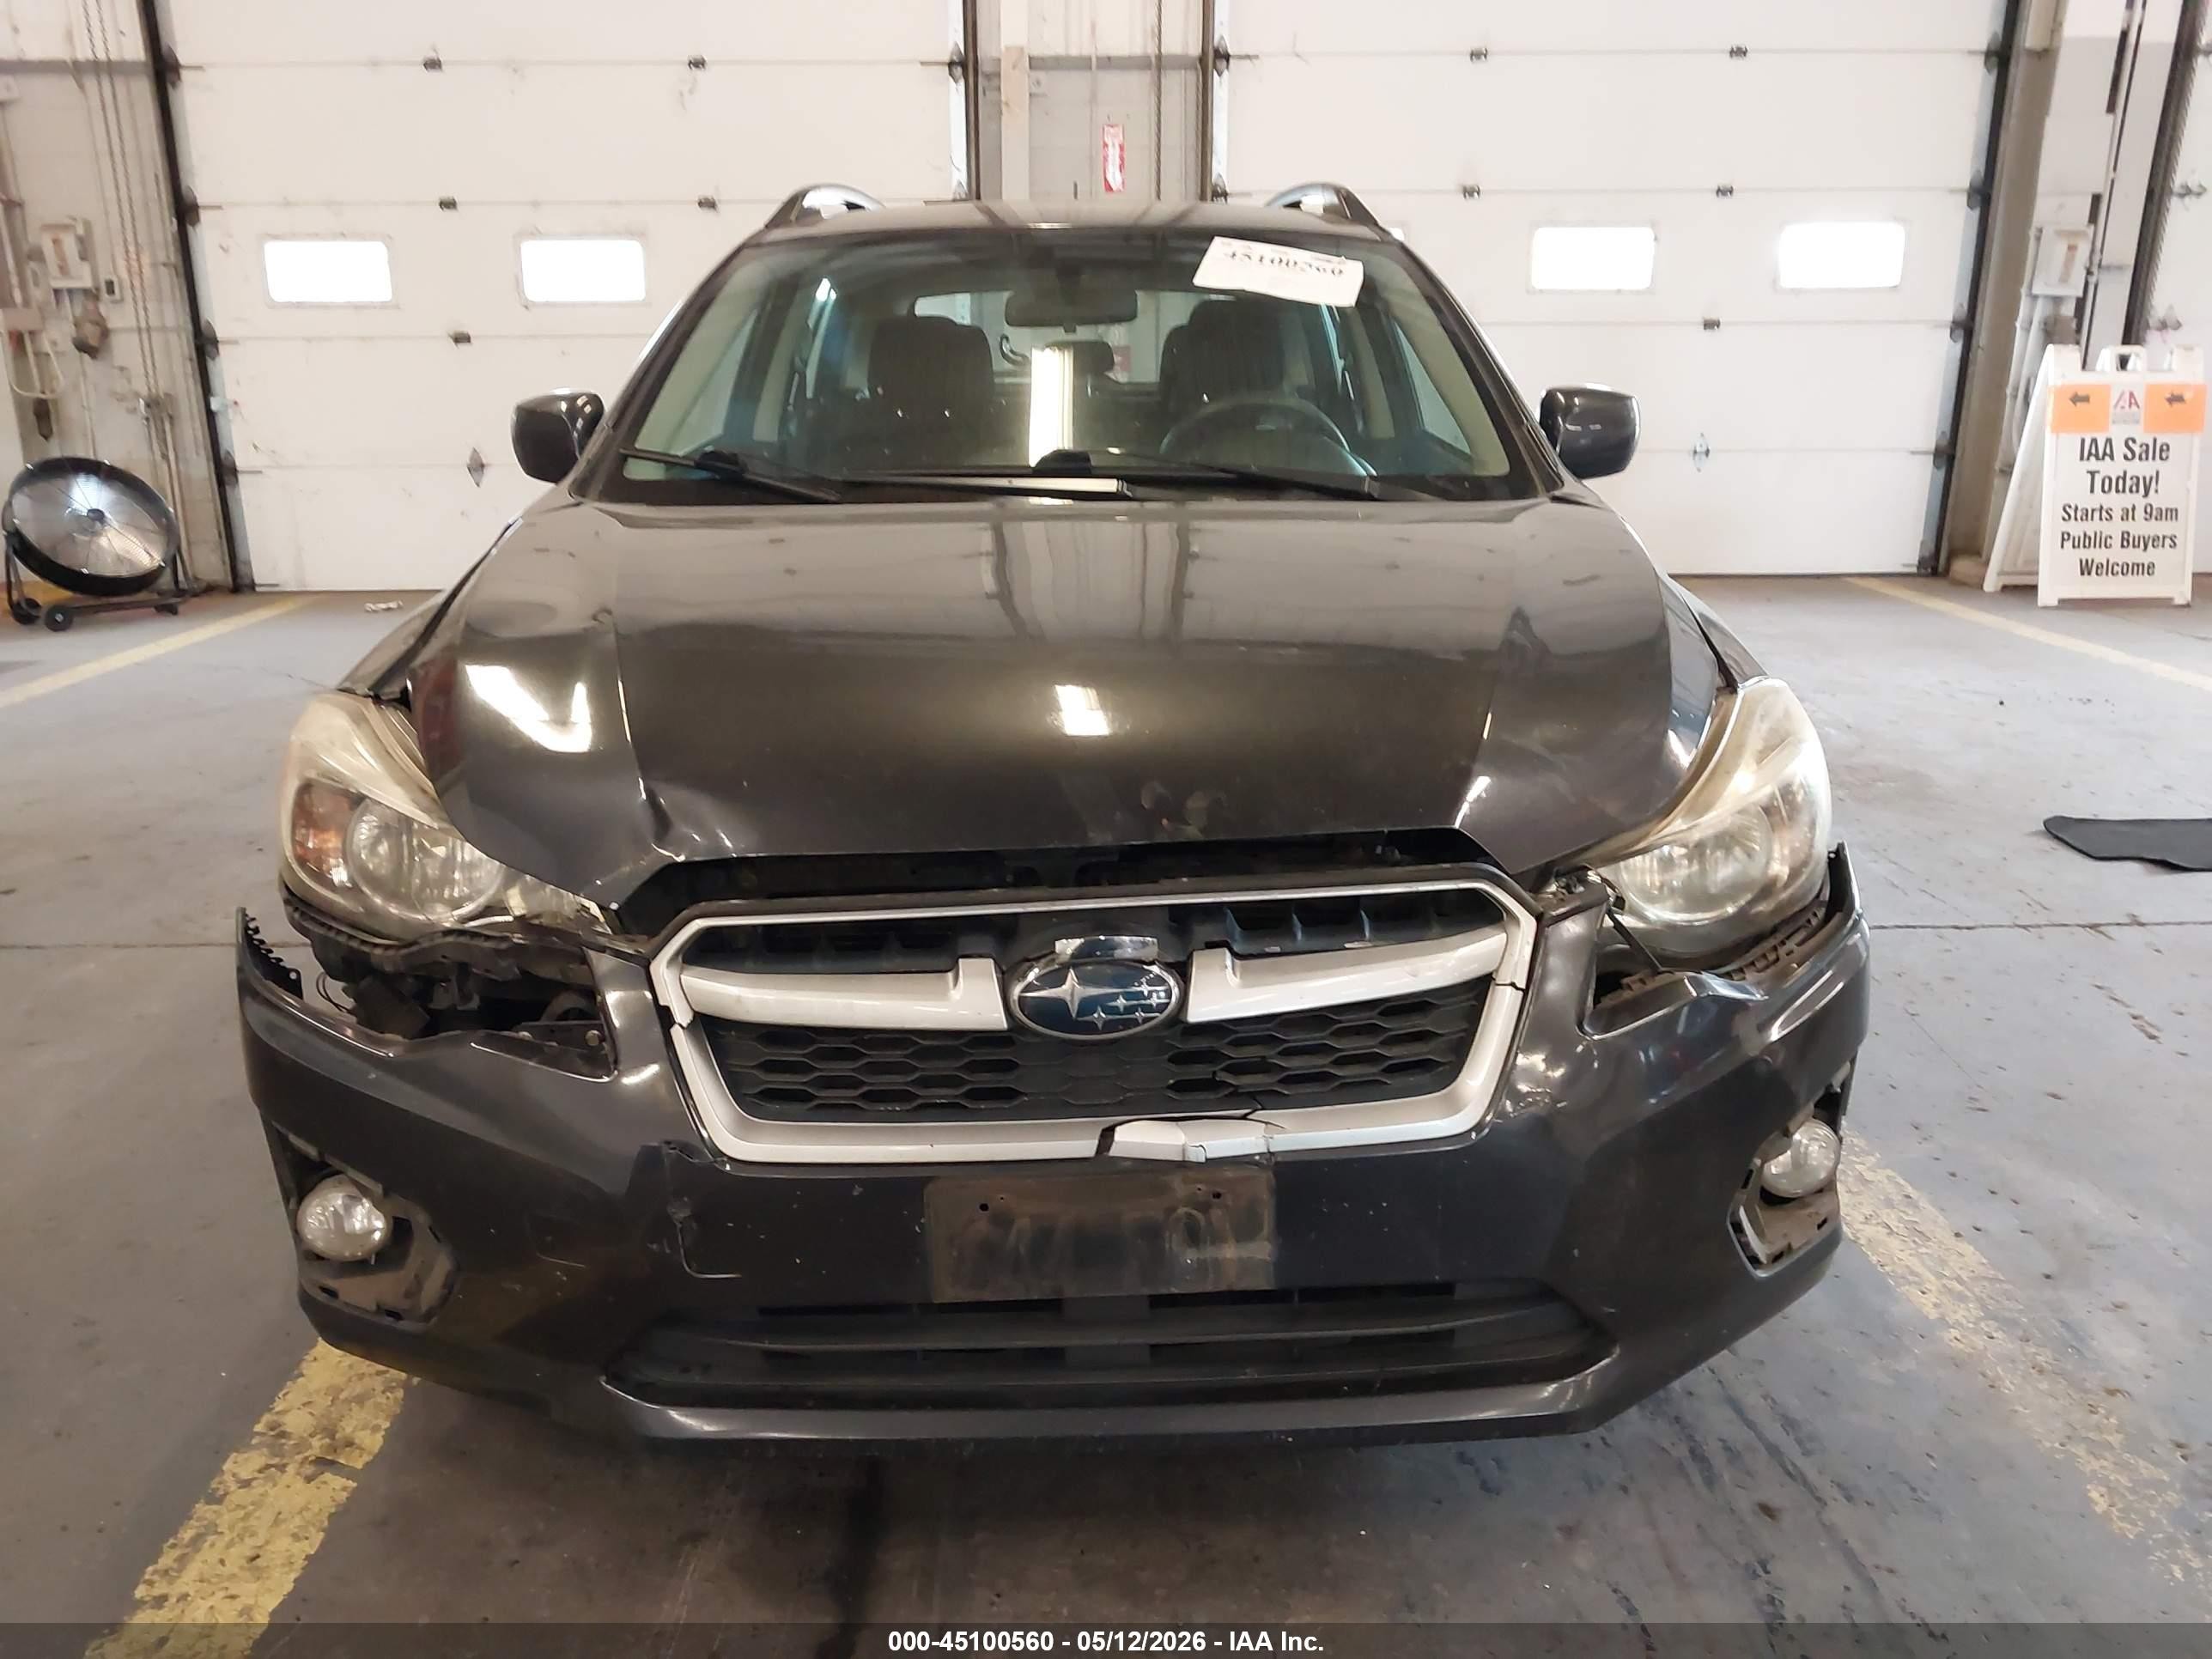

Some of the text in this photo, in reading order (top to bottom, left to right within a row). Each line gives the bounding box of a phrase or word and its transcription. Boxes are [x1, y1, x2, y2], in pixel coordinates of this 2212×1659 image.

[2079, 436, 2171, 462] IAA Sale
[2086, 470, 2160, 498] Today!
[2061, 502, 2179, 522] Starts at 9am
[2060, 530, 2178, 552] Public Buyers
[2078, 557, 2155, 577] Welcome
